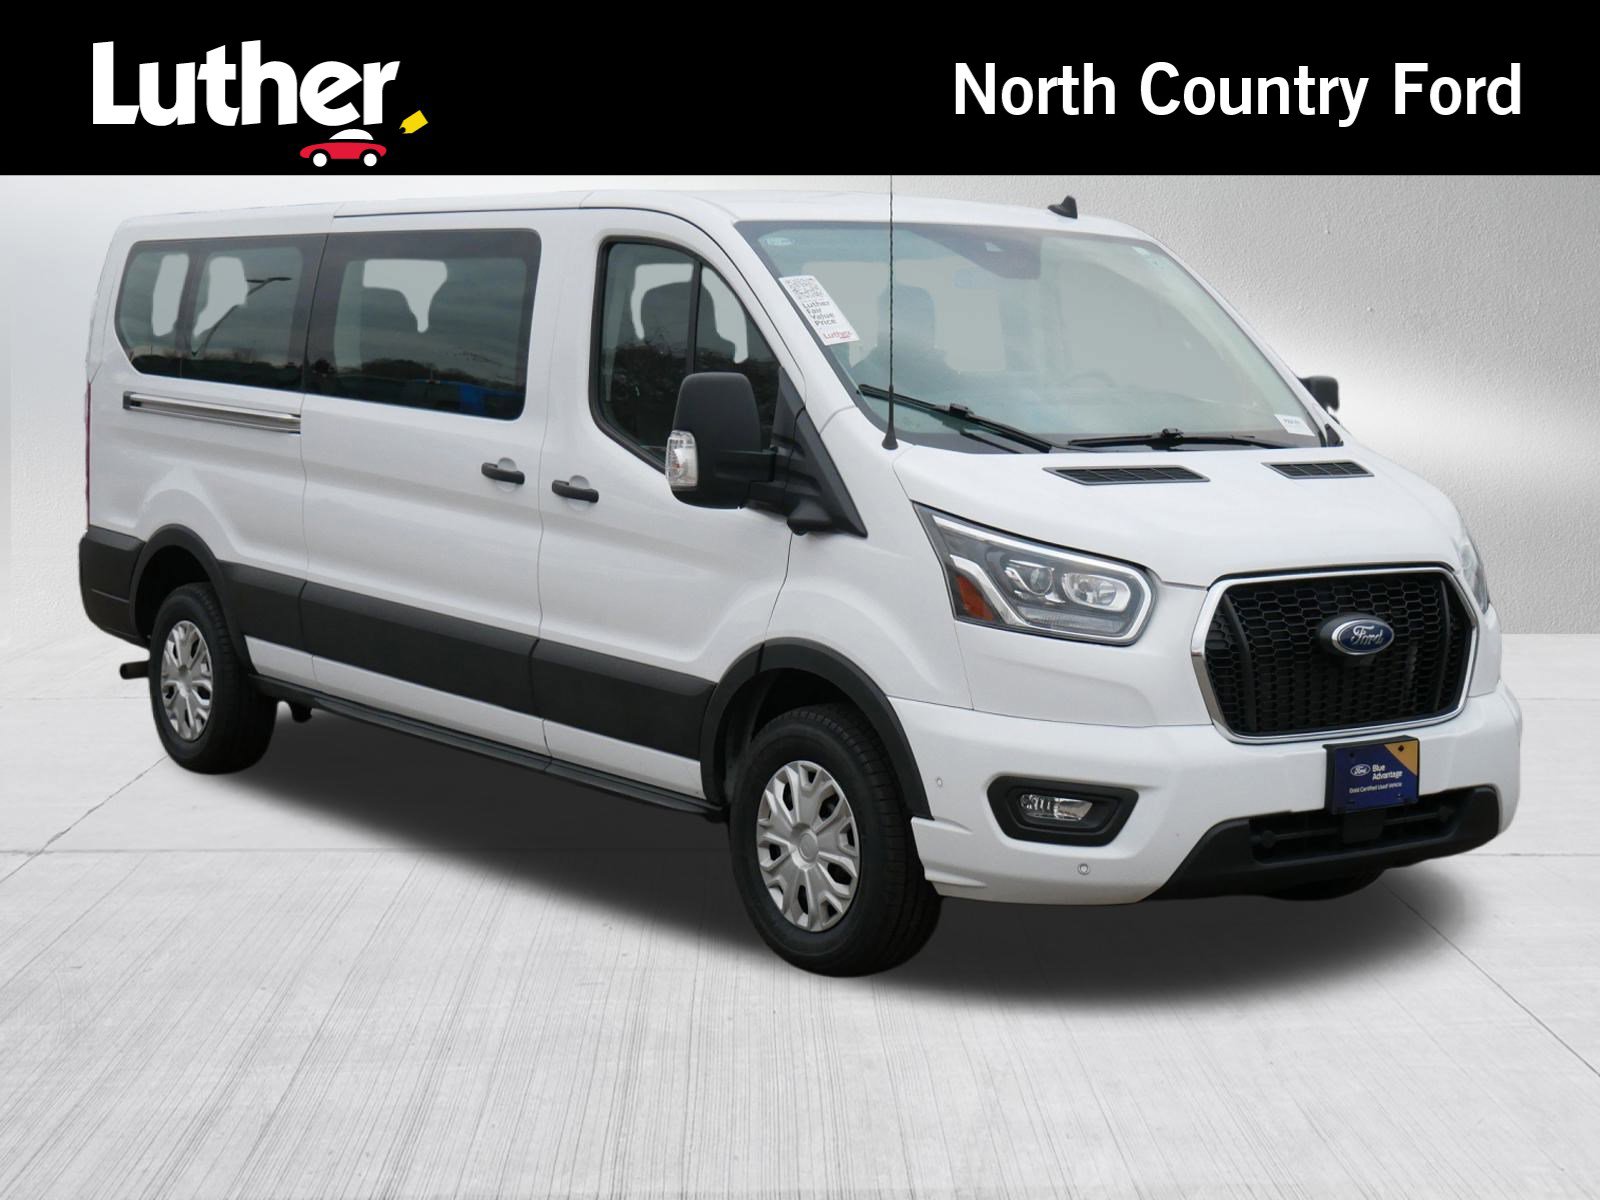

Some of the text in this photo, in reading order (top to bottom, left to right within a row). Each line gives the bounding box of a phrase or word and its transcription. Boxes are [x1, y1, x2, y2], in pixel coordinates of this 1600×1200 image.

[823, 331, 852, 340] Luther
[1351, 625, 1384, 645] Ford
[1372, 764, 1386, 772] Blue
[1372, 771, 1403, 780] Advantage
